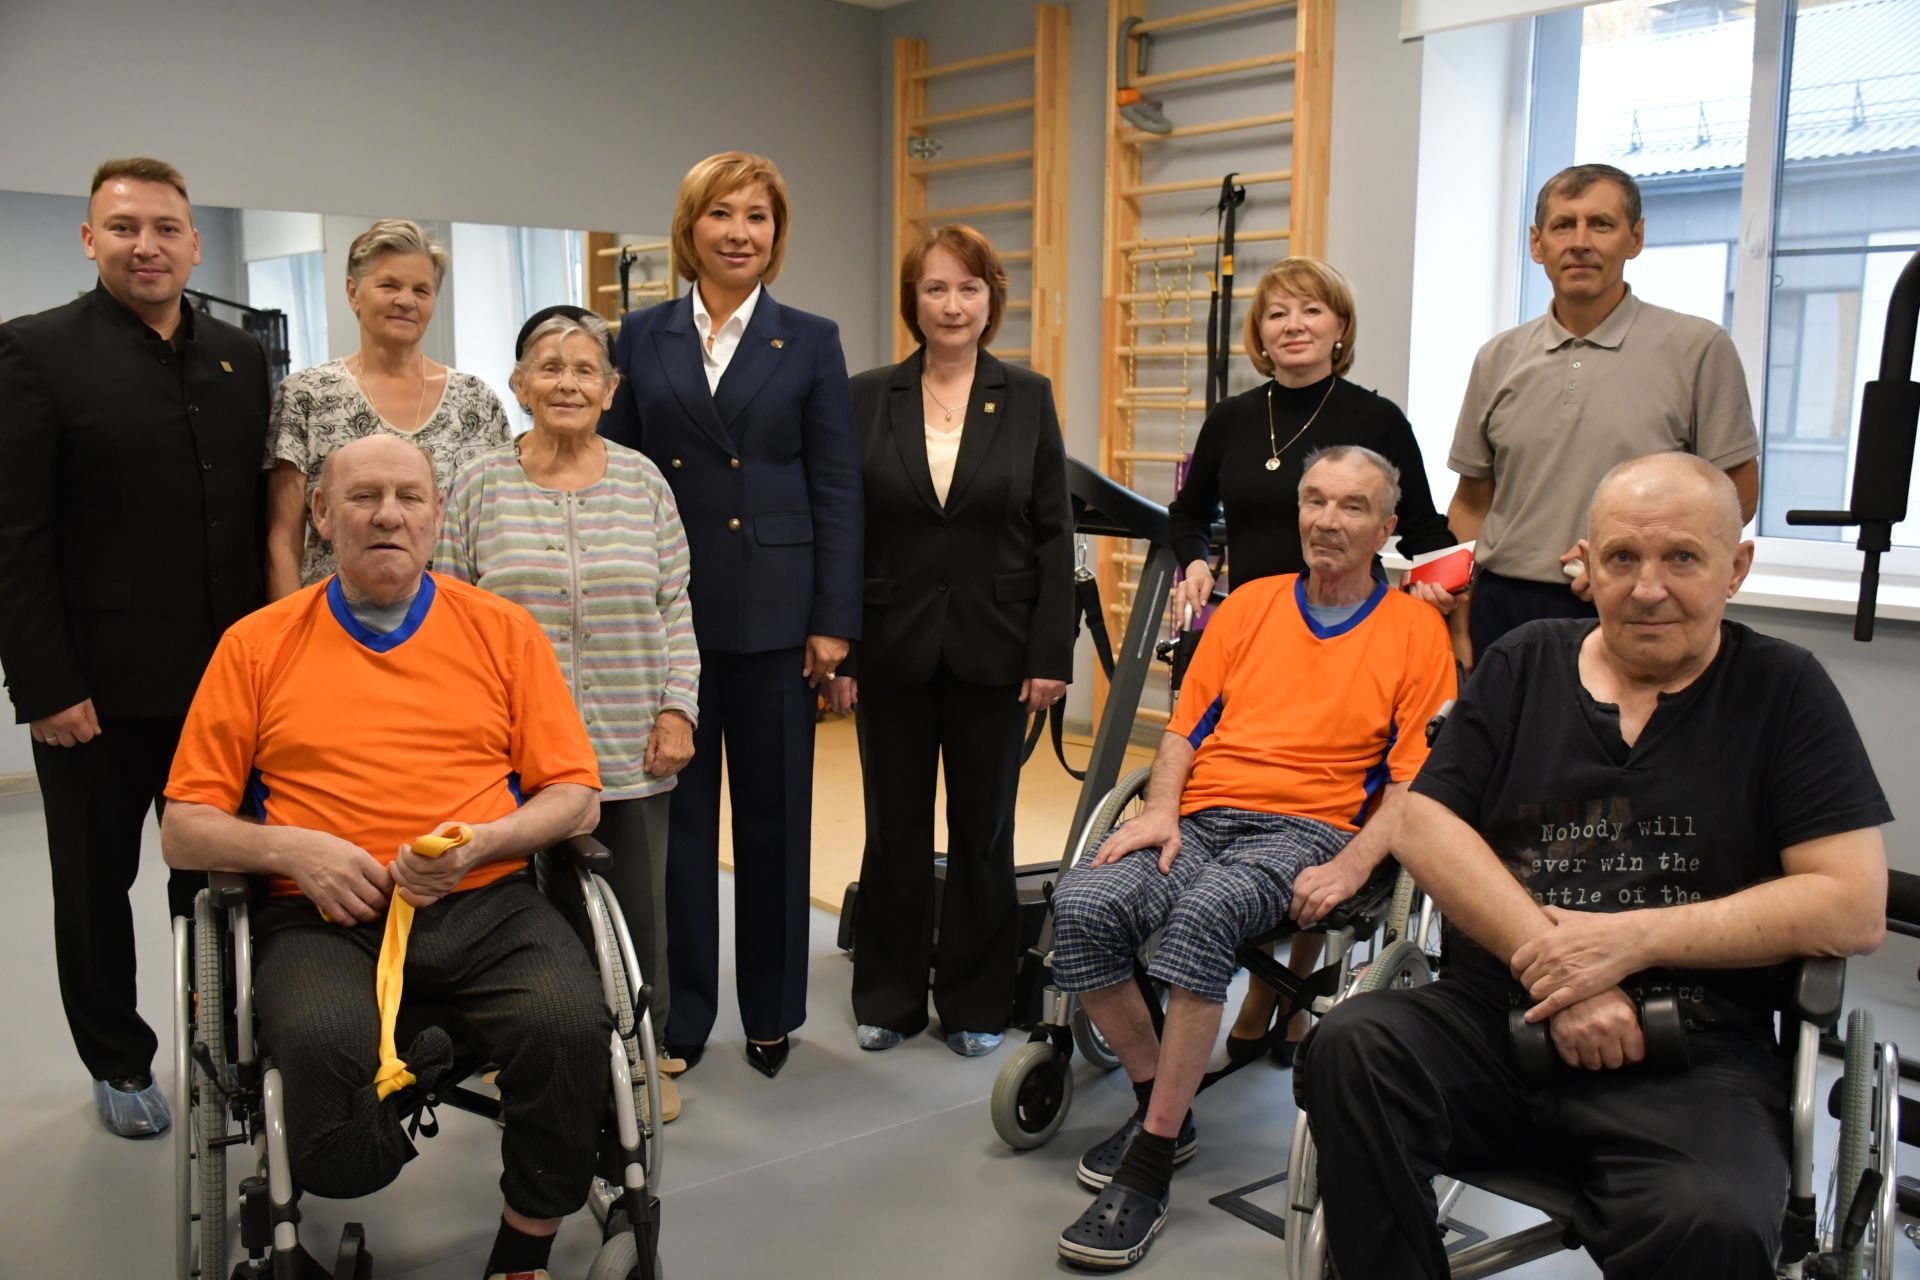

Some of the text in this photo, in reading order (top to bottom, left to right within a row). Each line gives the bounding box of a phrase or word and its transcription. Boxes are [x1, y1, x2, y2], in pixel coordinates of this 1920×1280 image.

[1541, 816, 1697, 842] Nobody will
[1532, 852, 1700, 873] ever win the
[1532, 885, 1701, 905] attle of the
